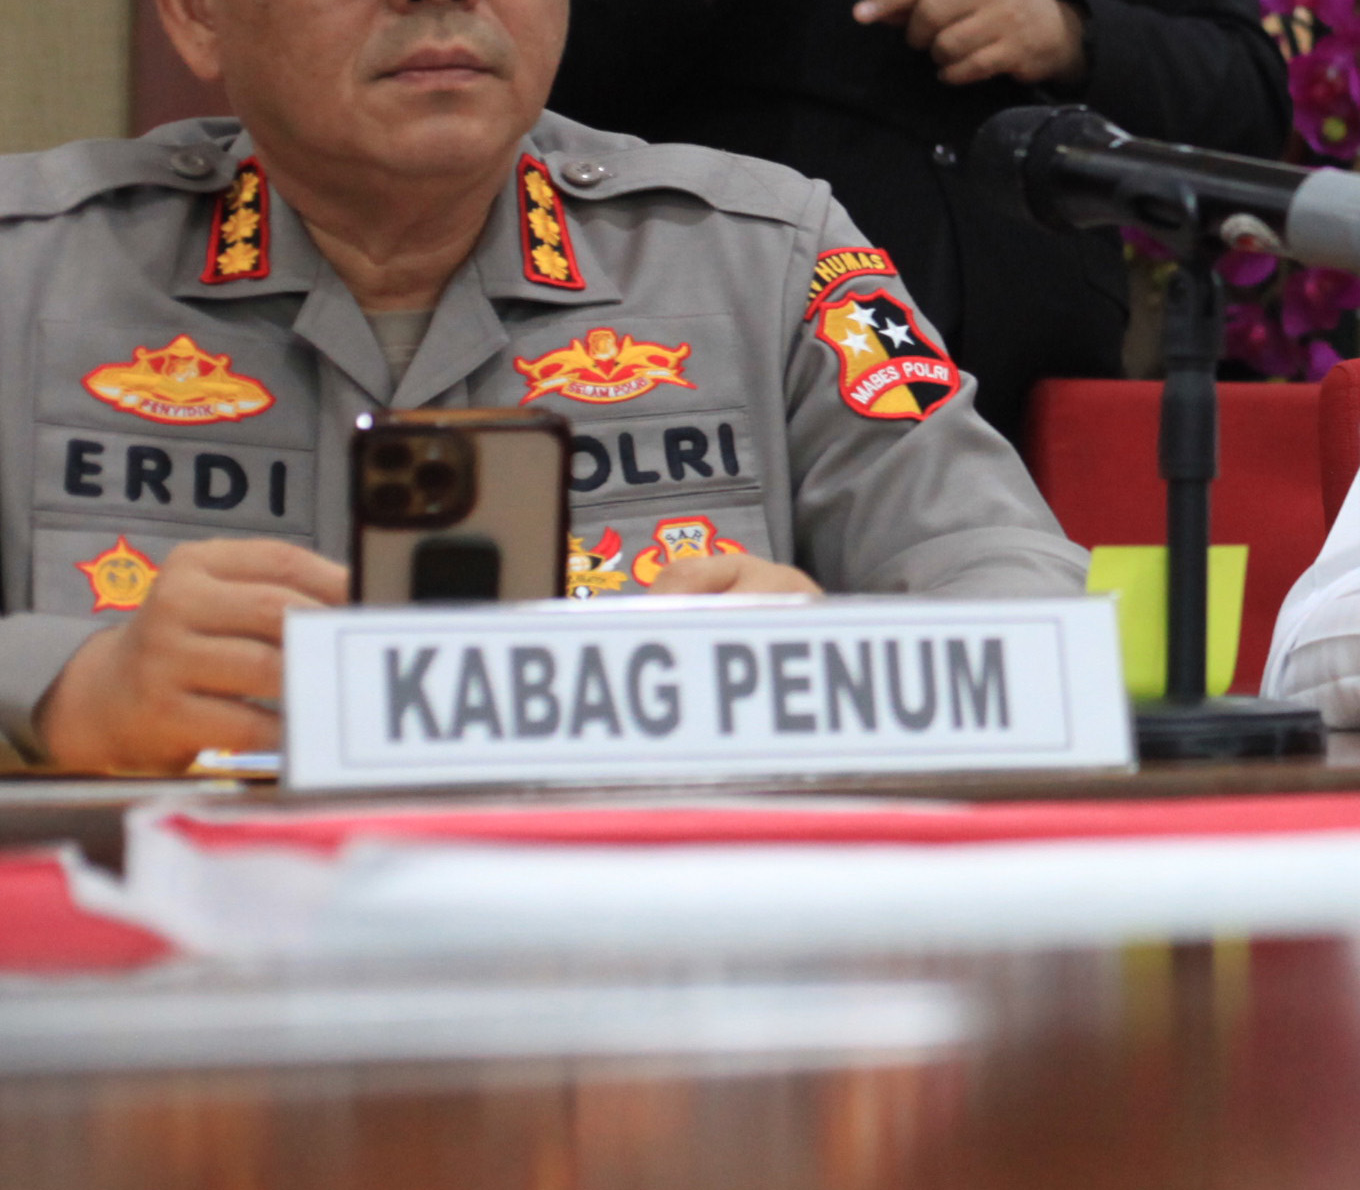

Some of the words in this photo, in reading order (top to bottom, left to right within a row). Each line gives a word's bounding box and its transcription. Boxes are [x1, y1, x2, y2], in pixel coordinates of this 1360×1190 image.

[813, 251, 886, 284] HUMAS
[850, 365, 900, 405] MABES
[902, 361, 949, 381] POLRI
[64, 438, 288, 518] ERDI
[569, 422, 740, 492] OLRI
[384, 642, 682, 744] KABAG
[713, 637, 1010, 736] PENUM
